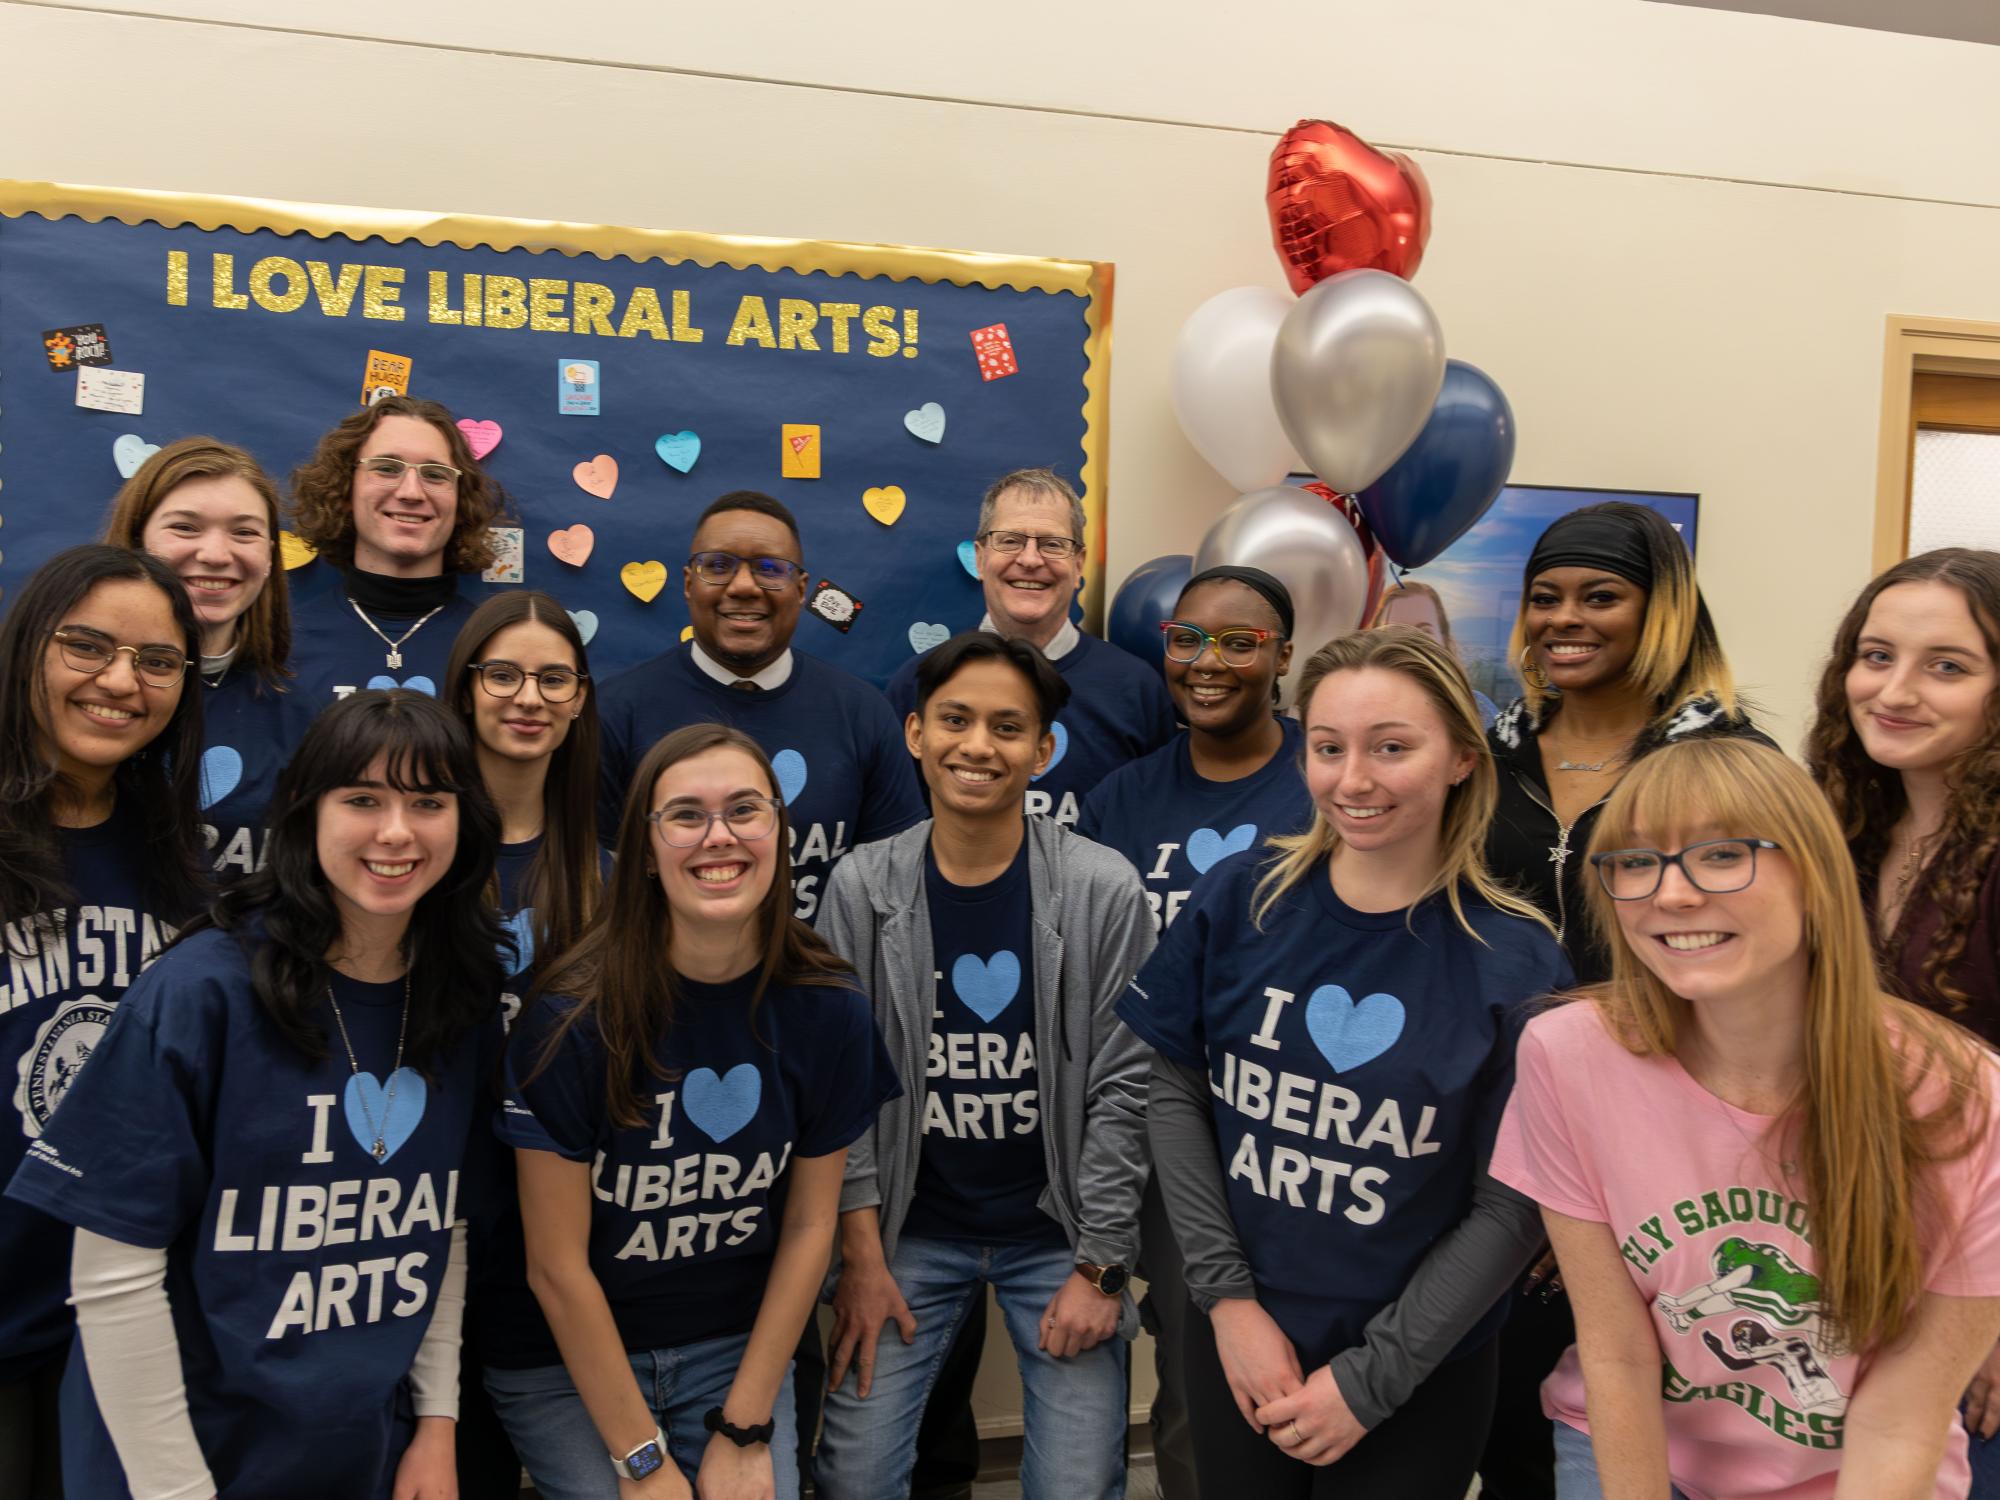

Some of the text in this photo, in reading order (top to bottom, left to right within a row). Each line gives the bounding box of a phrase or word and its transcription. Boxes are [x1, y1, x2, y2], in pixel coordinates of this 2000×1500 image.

[167, 250, 919, 359] I LOVE LIBERAL ARTS!
[1146, 843, 1182, 879] I
[0, 905, 181, 1014] NN STA
[1249, 986, 1295, 1051] I
[925, 1032, 1038, 1080] BERA
[302, 1093, 336, 1164] I
[650, 1090, 675, 1150] I
[921, 1089, 1040, 1140] ARTS
[1229, 1132, 1391, 1226] ARTS
[613, 1206, 765, 1262] ARTS
[1621, 1186, 1813, 1275] FLY SAQUO
[265, 1252, 430, 1340] ARTS
[1663, 1362, 1845, 1450] EAGLES
